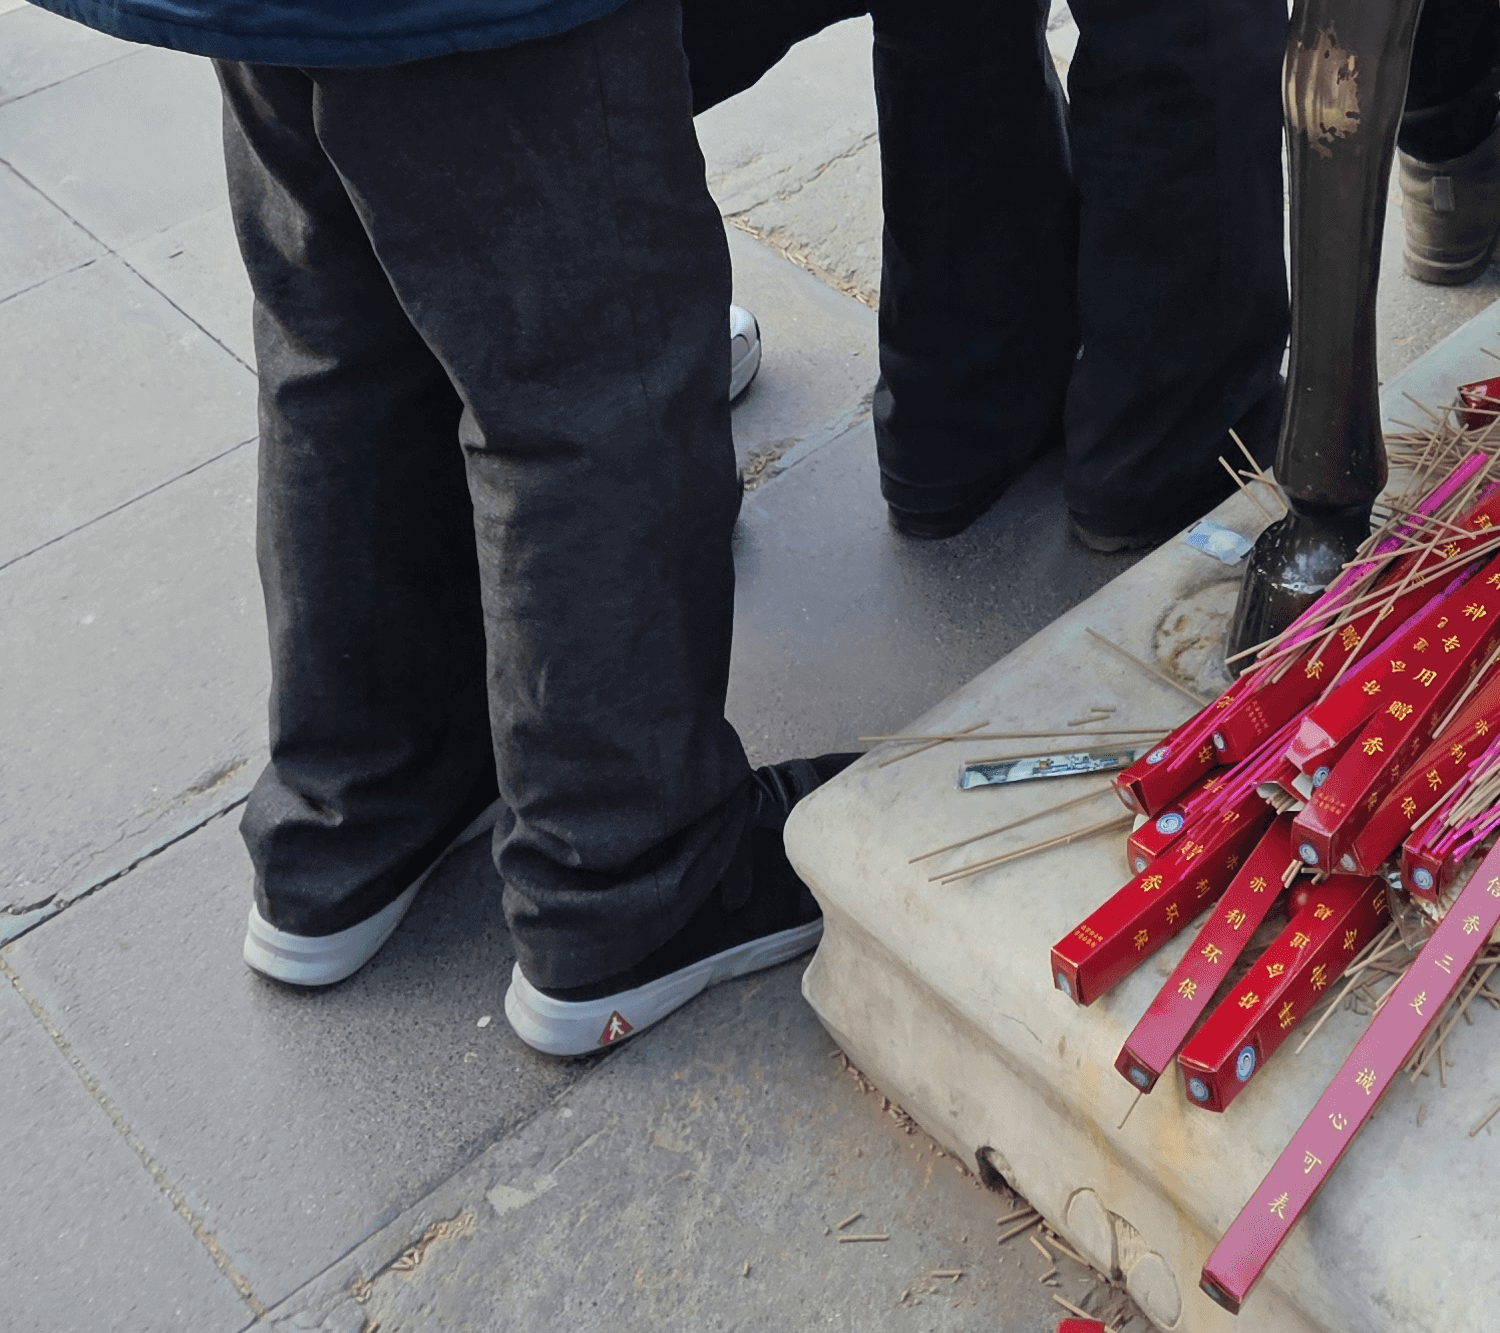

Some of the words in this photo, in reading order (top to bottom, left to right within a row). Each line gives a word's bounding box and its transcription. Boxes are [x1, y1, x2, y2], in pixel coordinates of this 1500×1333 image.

[1177, 875, 1267, 1001] 亦利环保
[1267, 1067, 1377, 1221] 诚心可表
